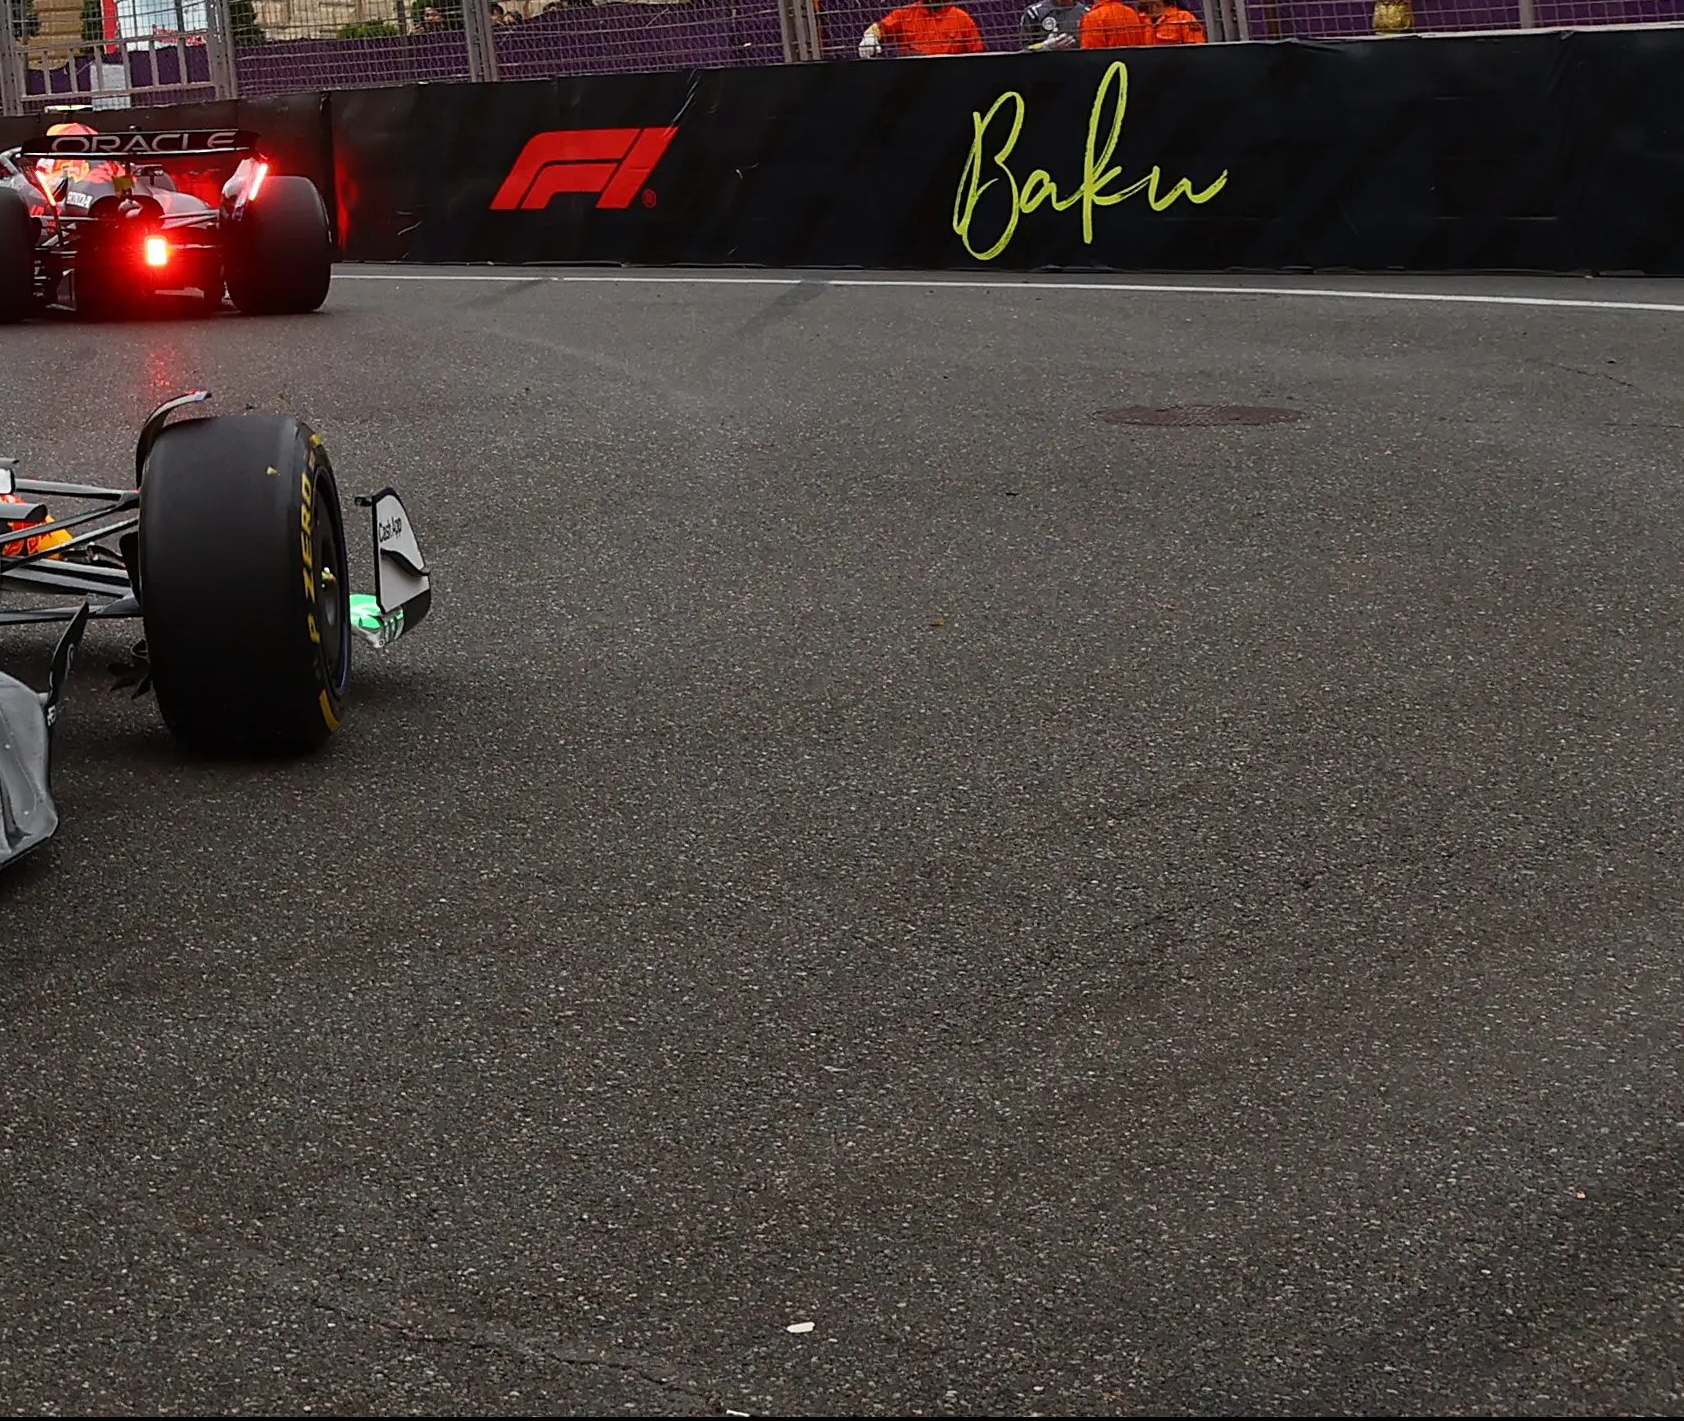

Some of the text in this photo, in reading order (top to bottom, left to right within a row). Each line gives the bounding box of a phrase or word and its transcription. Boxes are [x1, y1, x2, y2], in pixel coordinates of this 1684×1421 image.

[51, 131, 237, 153] ORACLE
[489, 127, 679, 210] F1
[952, 60, 1228, 261] Baku
[300, 470, 317, 604] ZERO
